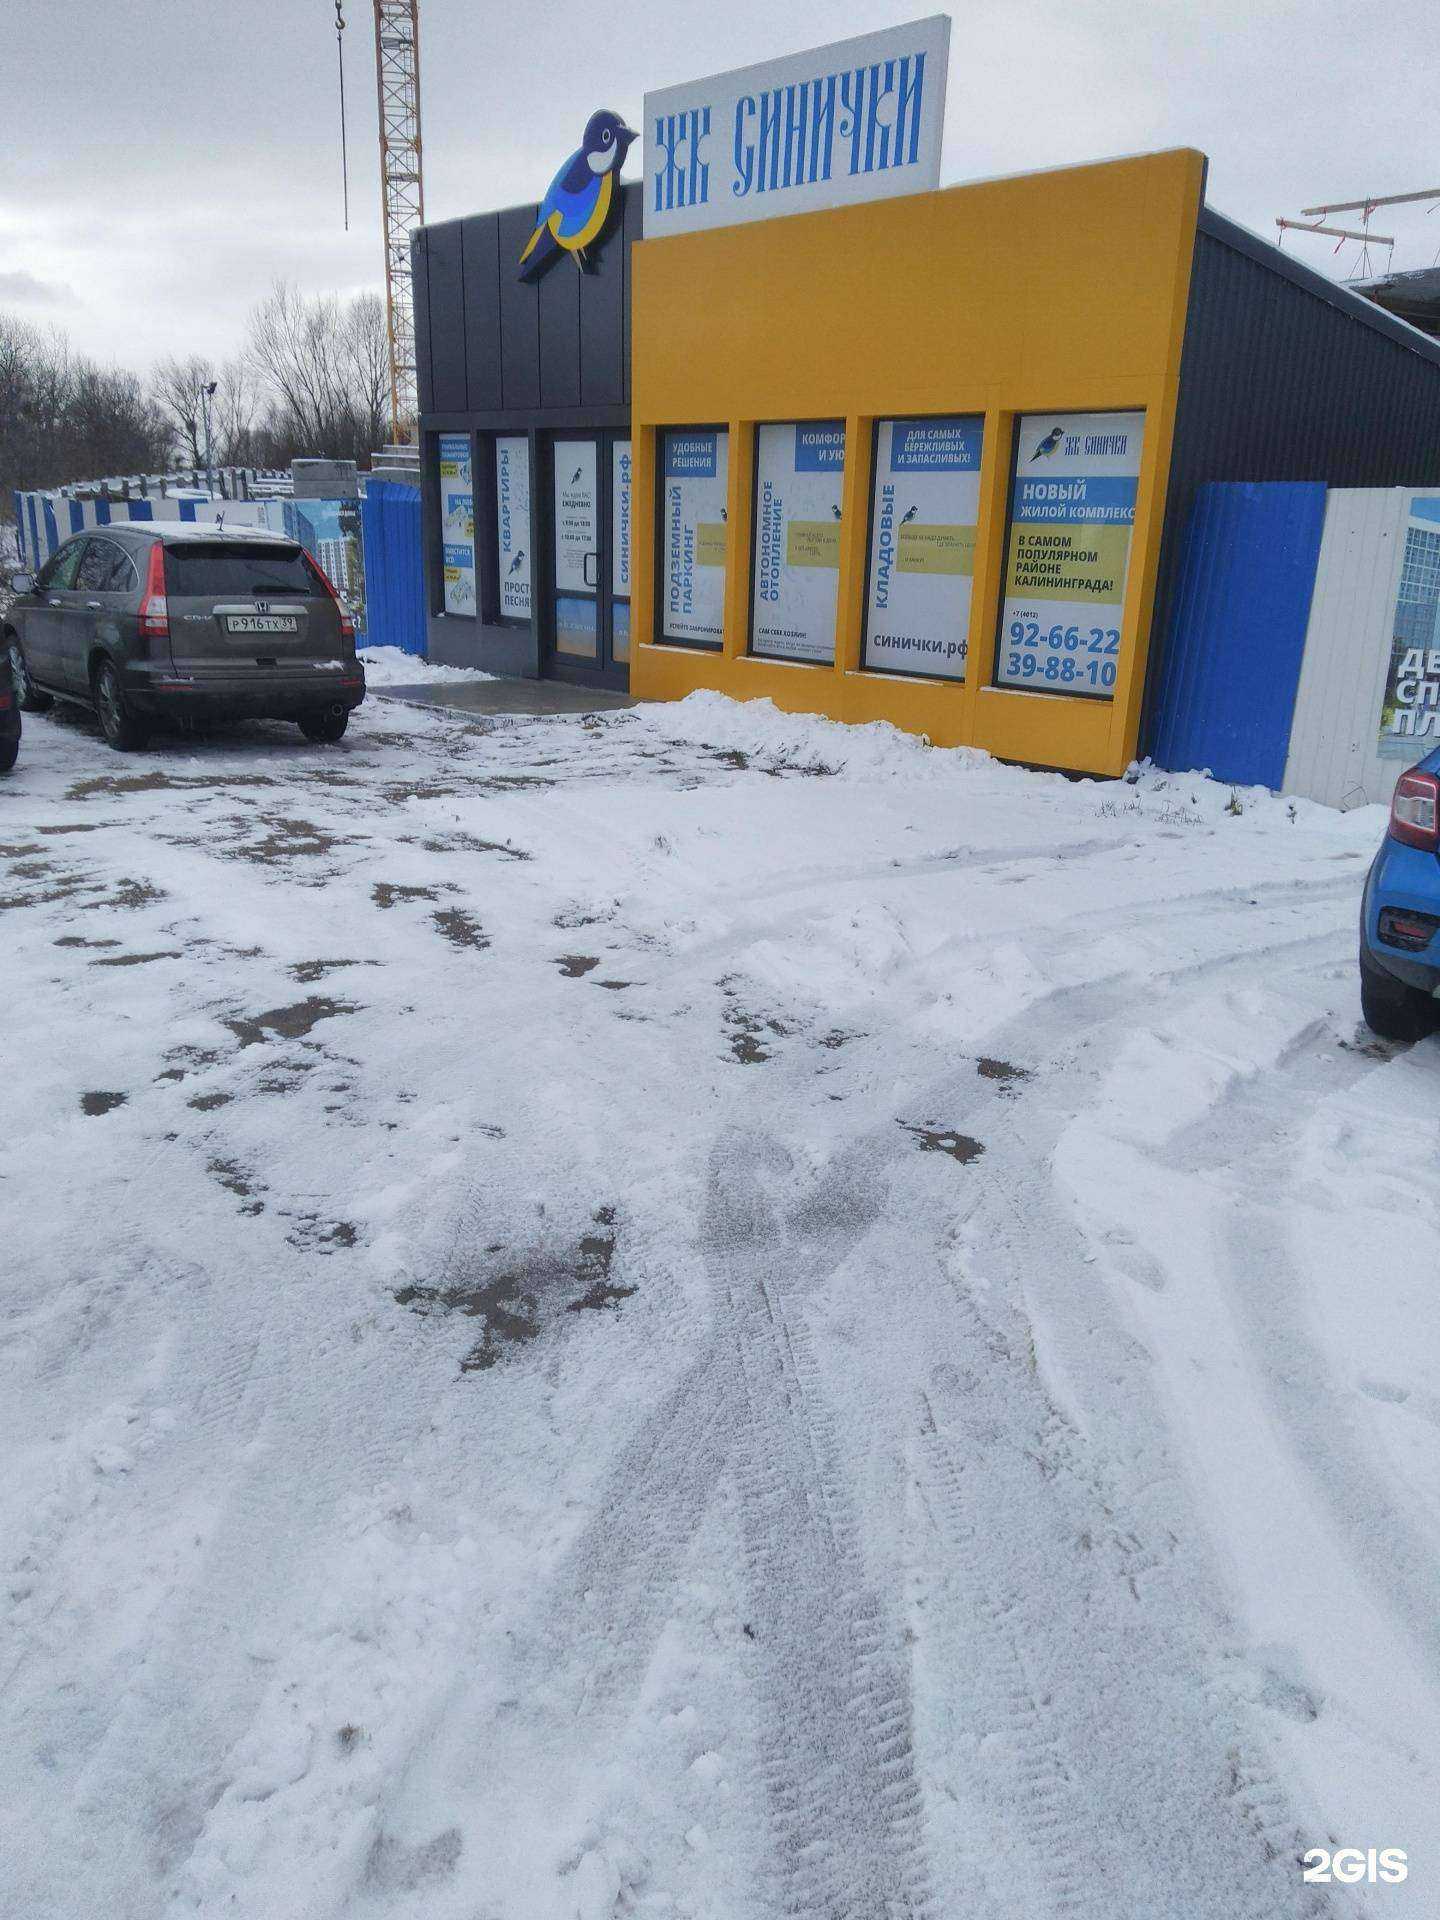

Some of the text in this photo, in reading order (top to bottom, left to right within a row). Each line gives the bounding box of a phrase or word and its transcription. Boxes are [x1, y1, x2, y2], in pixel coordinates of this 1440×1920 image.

[654, 50, 928, 212] ЖК СИНИЧКИ
[906, 429, 961, 441] ДЛЯ САМЫХ
[1064, 435, 1128, 456] ЖК СИНИЧКИ
[672, 441, 713, 455] УДОБНЫЕ
[818, 450, 827, 461] И
[904, 441, 965, 452] БЕРЕЖЛИВЫХ
[672, 457, 712, 468] РЕШЕНИЯ
[897, 453, 971, 464] И ЗАПАСЛИВЫХ!
[501, 447, 512, 553] КВАРТИРЫ
[1022, 478, 1087, 501] НОВЫЙ
[619, 453, 632, 584] синички.рф
[1020, 503, 1067, 518] ЖИЛОЙ
[669, 486, 683, 612] ПОДЗЕМНЫЙ
[760, 481, 773, 601] АВТОНОМНОЕ
[770, 499, 783, 601] ОТОПЛЕНИЕ
[876, 484, 895, 609] КЛАДОВЫЕ
[1018, 536, 1072, 548] В САМОМ
[1017, 549, 1098, 562] ПОПУЛЯРНОМ
[682, 524, 694, 614] ПАРКИНГ
[1016, 560, 1061, 575] РАЙОНЕ
[1014, 576, 1114, 593] КАЛИНИНГРАДА!
[504, 595, 530, 607] ПЕСНЯ
[873, 634, 968, 660] синички.рф
[1010, 621, 1121, 655] 92-66-22
[1006, 651, 1117, 687] 39-88-10
